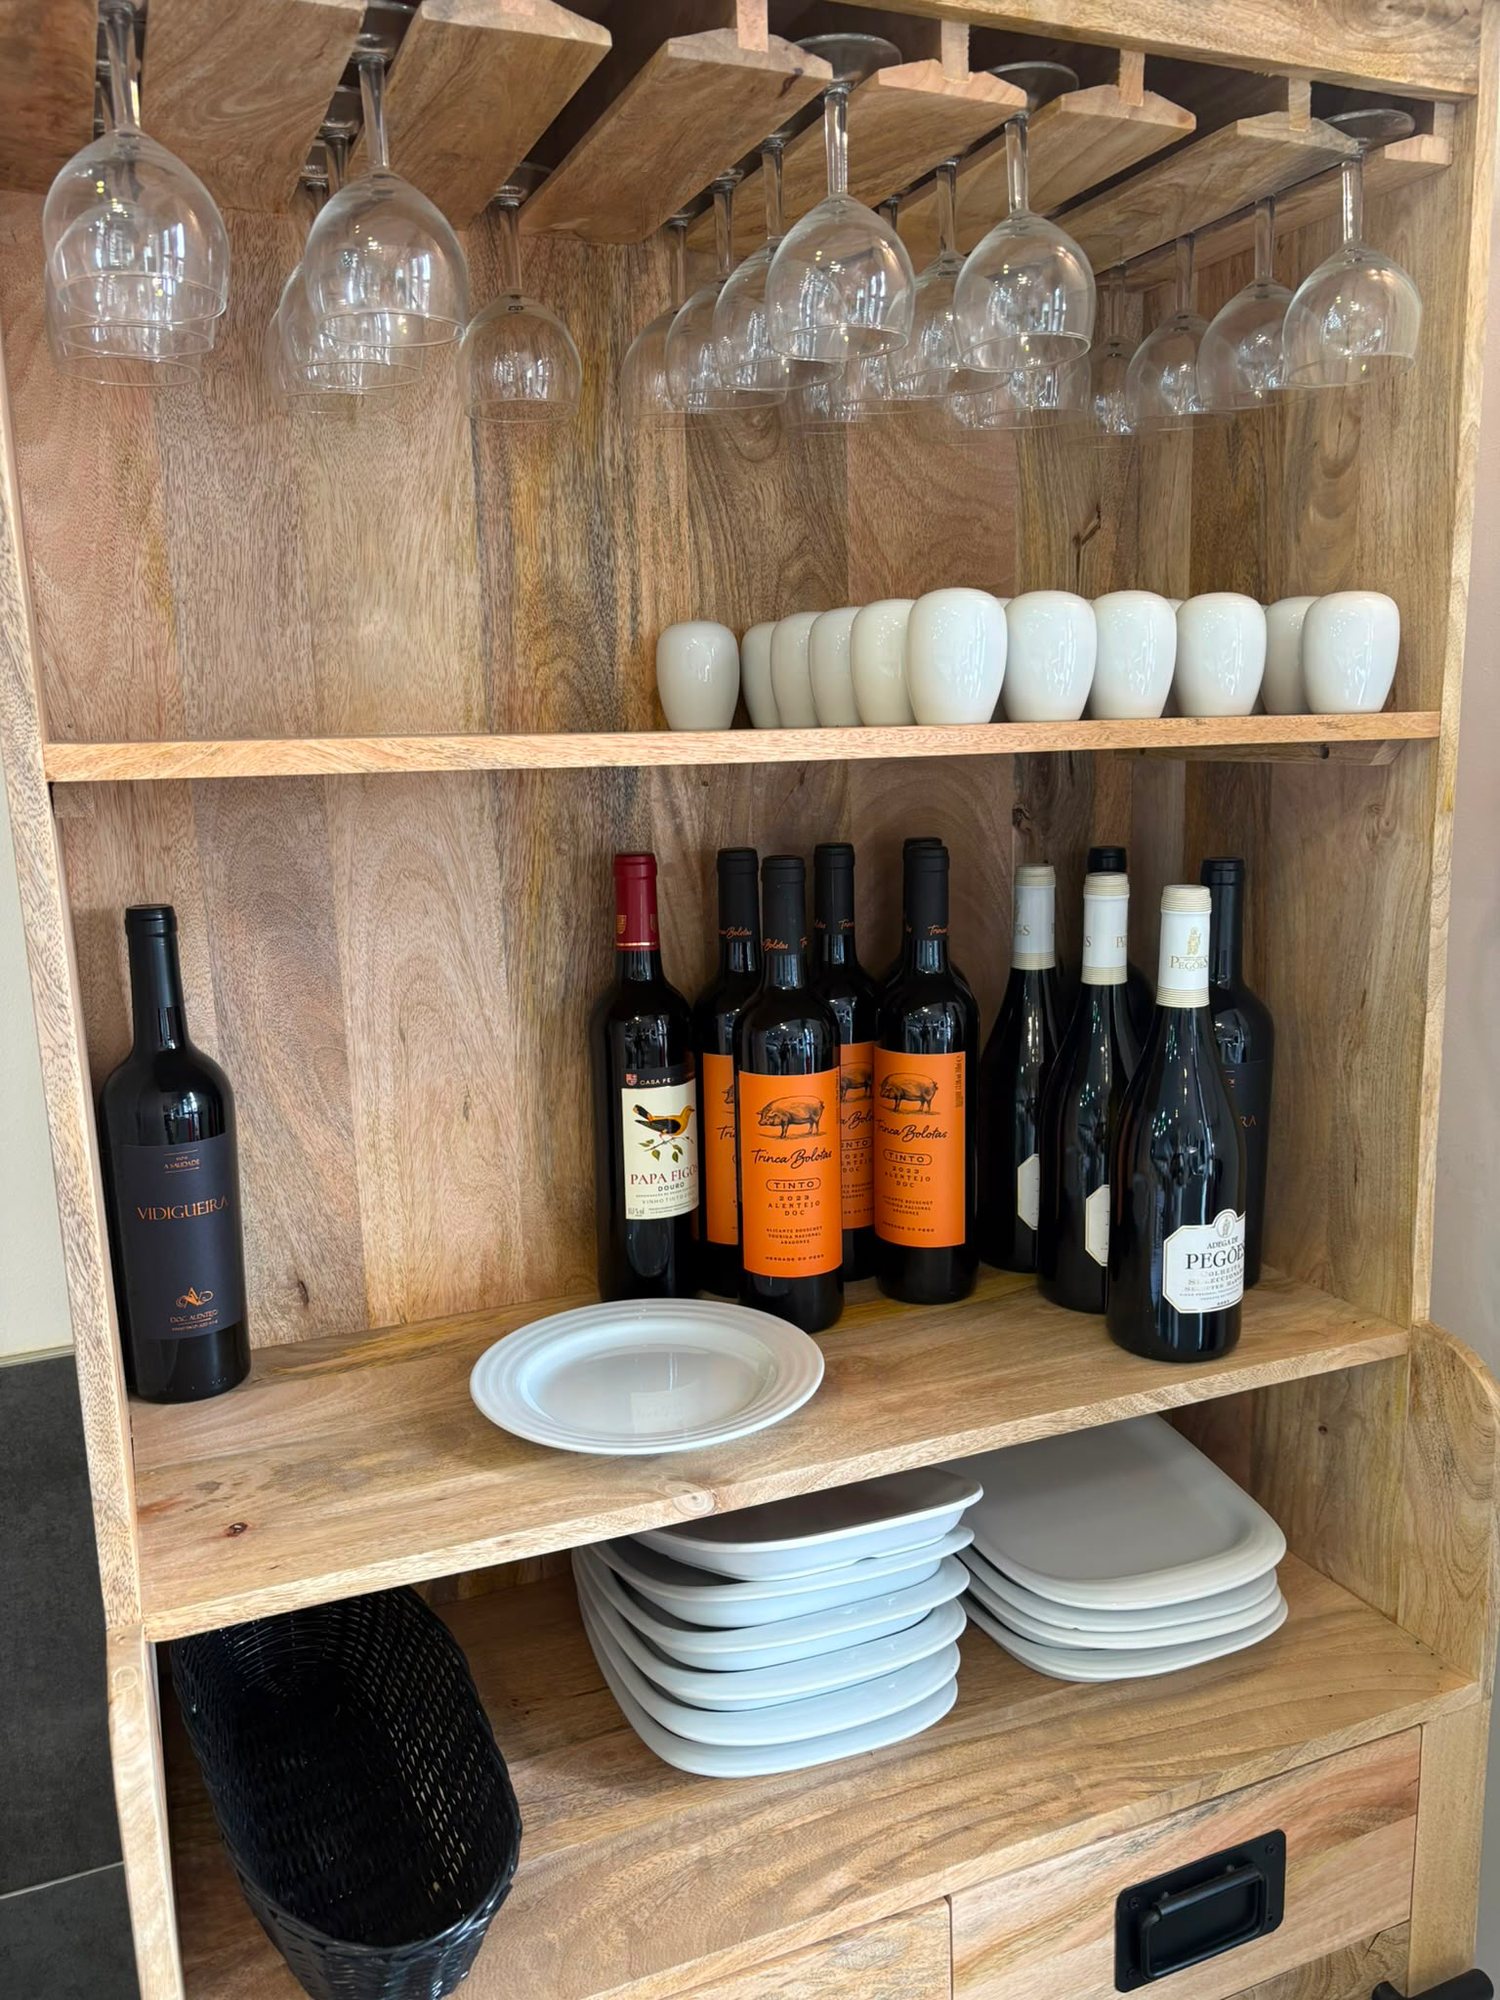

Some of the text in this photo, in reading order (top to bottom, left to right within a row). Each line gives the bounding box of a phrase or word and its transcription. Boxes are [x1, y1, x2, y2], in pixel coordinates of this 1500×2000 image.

[716, 1125, 736, 1140] Tri
[901, 1124, 948, 1143] Bolotas
[751, 1147, 833, 1170] Trinca Bolotas
[889, 1152, 925, 1163] TINTO
[630, 1172, 667, 1185] PAPA
[657, 1181, 685, 1192] DOURO
[773, 1180, 815, 1190] TINTO
[778, 1194, 810, 1202] 2023
[137, 1195, 230, 1221] VIDIGUEIRA
[768, 1200, 821, 1209] ALENTEJO
[784, 1209, 806, 1217] DOC
[1207, 1239, 1230, 1250] ADEGA
